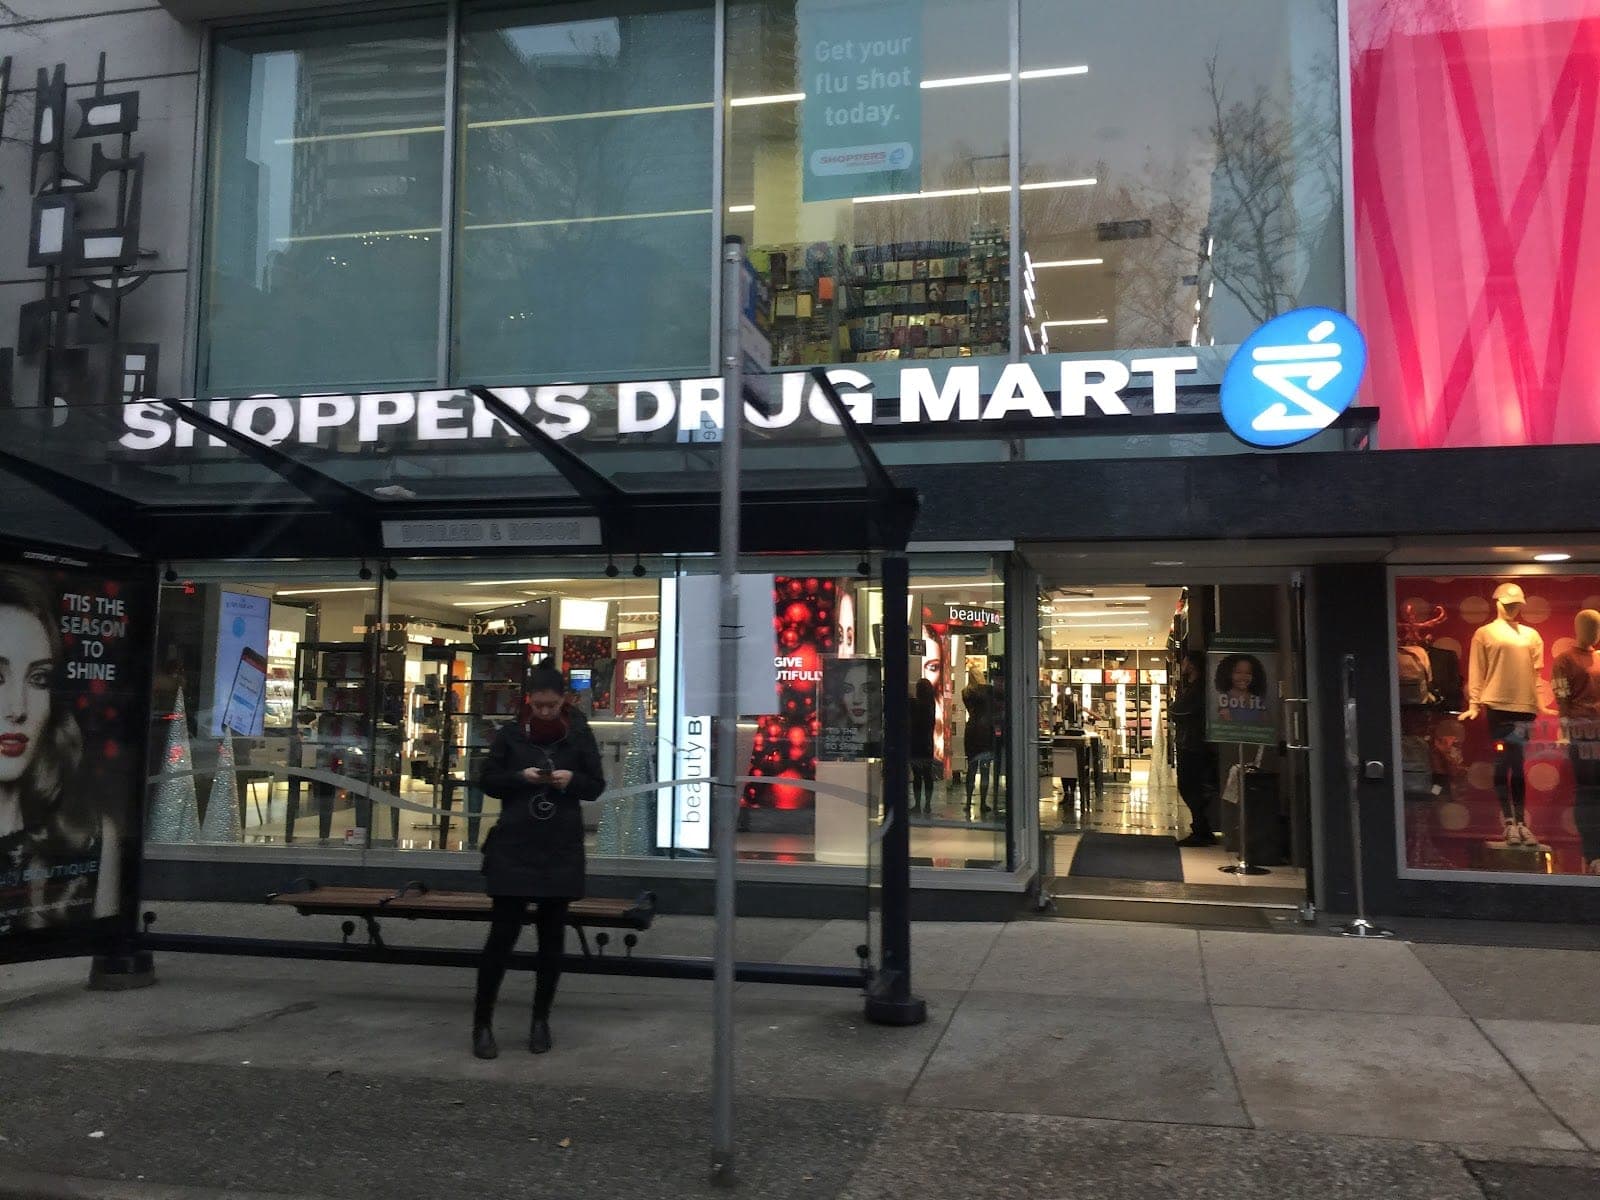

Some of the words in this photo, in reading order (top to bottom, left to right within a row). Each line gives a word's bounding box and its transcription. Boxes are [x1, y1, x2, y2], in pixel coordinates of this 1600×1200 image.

[815, 39, 854, 62] Get
[860, 36, 912, 63] your
[815, 72, 848, 95] flu
[856, 66, 912, 92] shot
[825, 101, 900, 127] today.
[818, 151, 887, 165] SHOPPERS
[900, 356, 1198, 422] MART
[95, 597, 125, 617] THE
[61, 616, 125, 638] SEASON
[81, 641, 104, 658] TO
[67, 661, 116, 681] SHINE
[773, 656, 802, 667] GIVE
[1219, 694, 1248, 710] Got
